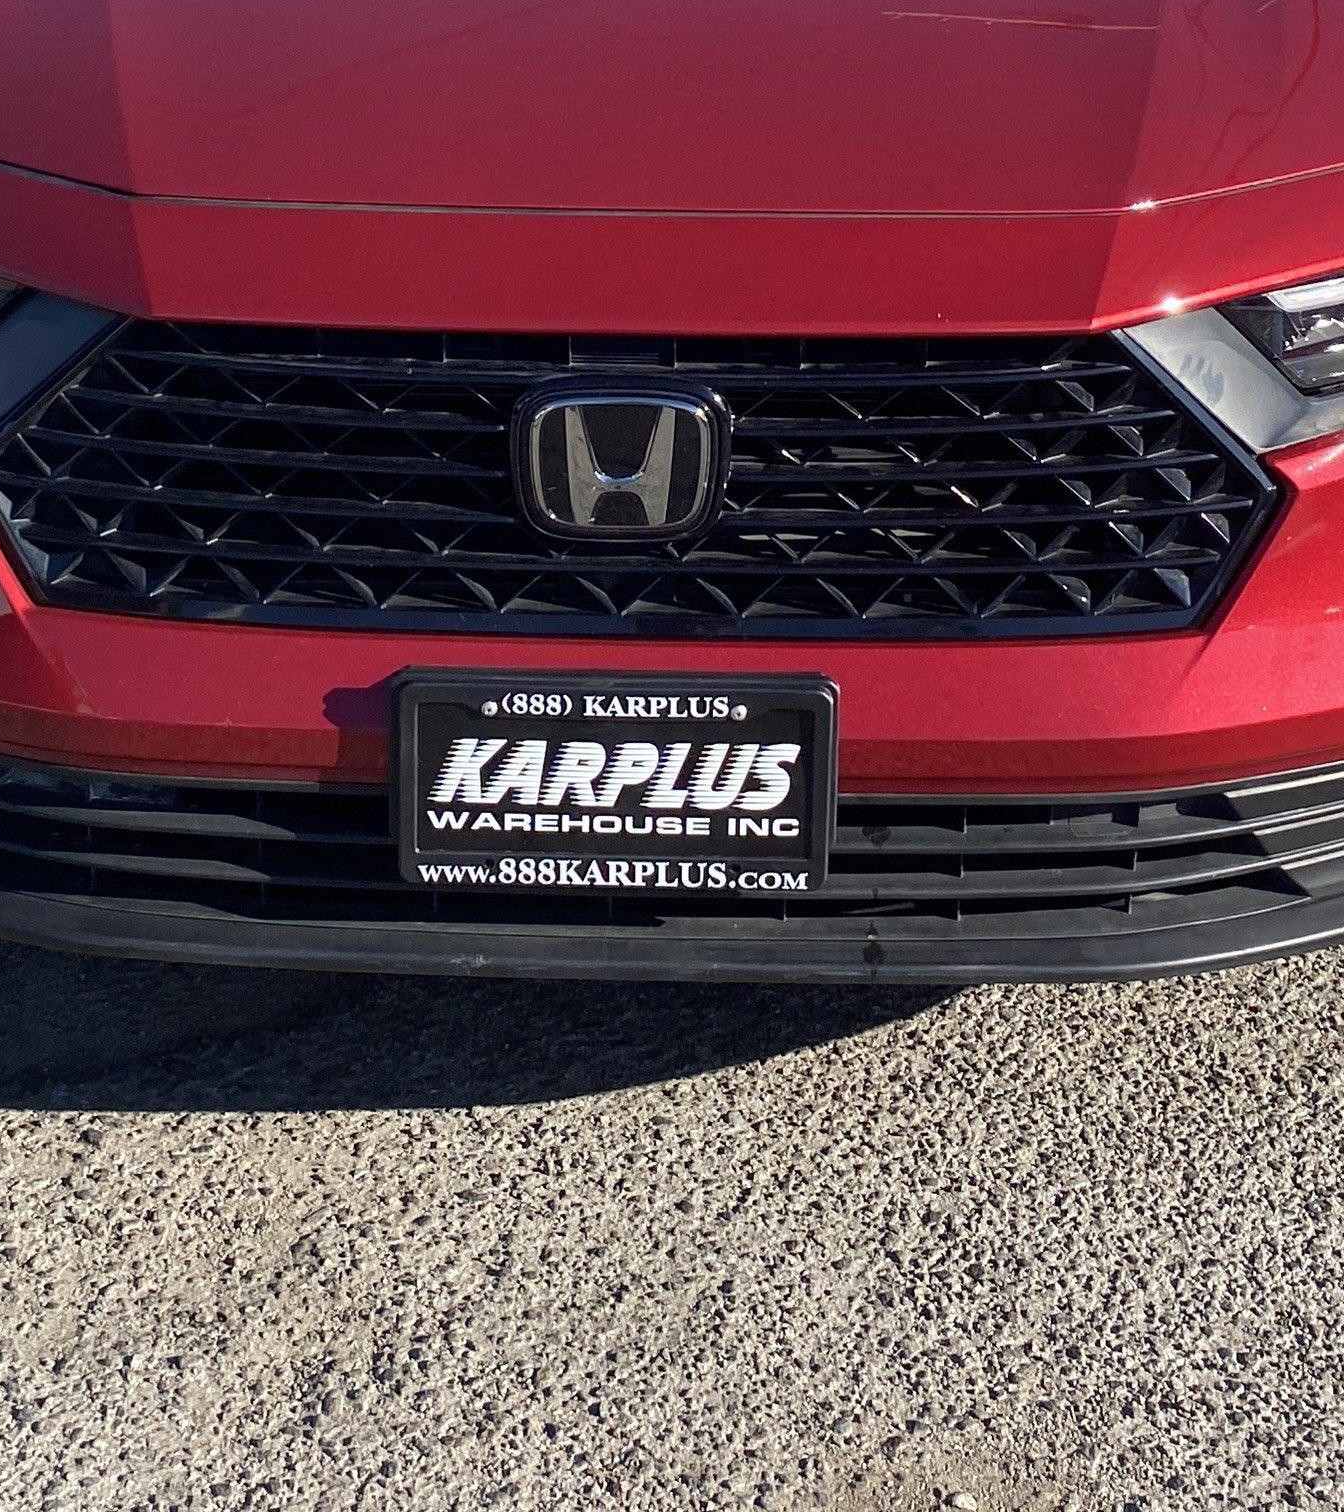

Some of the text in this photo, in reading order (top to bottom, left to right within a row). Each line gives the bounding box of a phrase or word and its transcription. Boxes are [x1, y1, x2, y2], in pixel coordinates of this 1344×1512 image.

[501, 692, 730, 720] (888) KARPLUS
[426, 737, 802, 811] KARPLUS
[426, 810, 801, 837] WAREHOUSE INC
